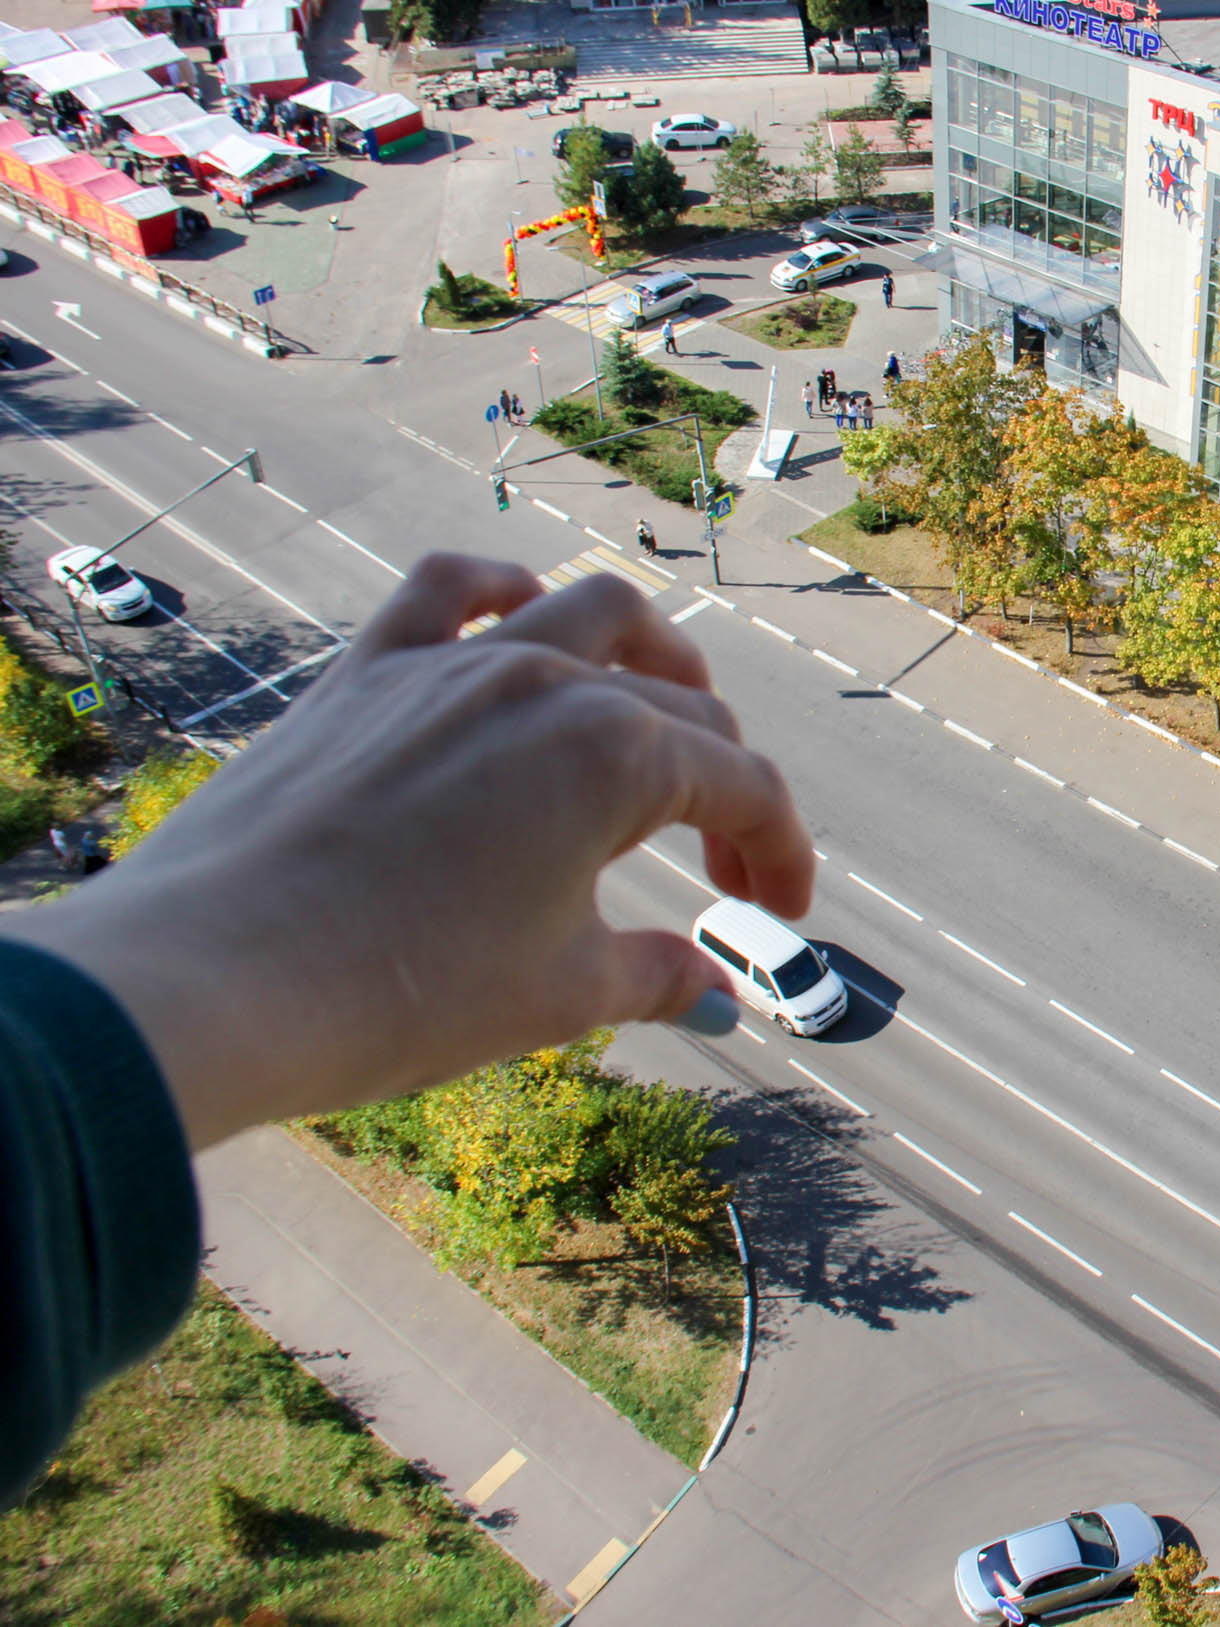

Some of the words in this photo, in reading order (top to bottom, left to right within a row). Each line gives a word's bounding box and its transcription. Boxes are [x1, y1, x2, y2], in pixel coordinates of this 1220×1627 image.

[994, 0, 1162, 58] КИНОТЕАТР
[1068, 0, 1136, 20] ars
[1148, 97, 1195, 137] ТРЦ
